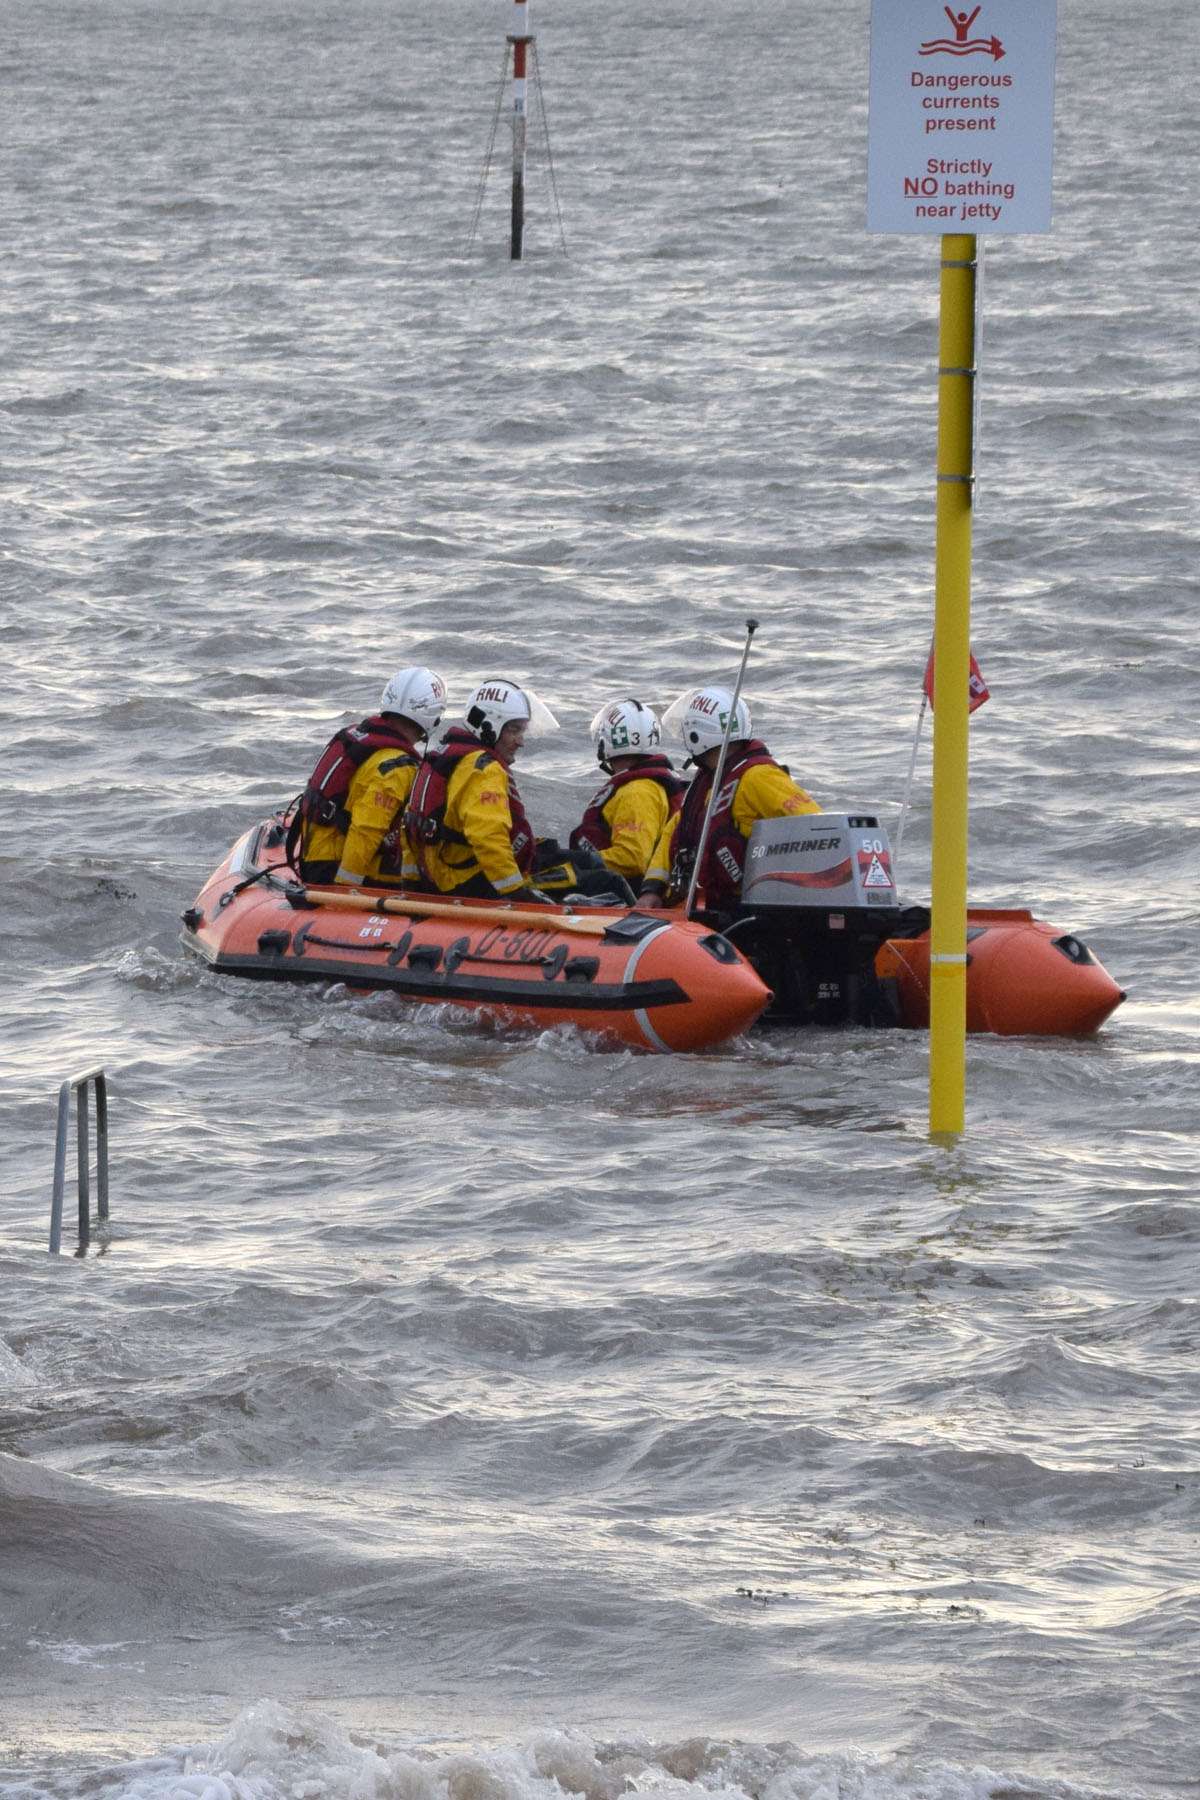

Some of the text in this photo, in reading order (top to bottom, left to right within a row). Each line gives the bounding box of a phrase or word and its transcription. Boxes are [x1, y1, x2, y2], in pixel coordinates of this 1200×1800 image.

[911, 72, 1013, 91] Dangerous
[922, 94, 1000, 109] currents
[925, 116, 997, 134] present
[926, 158, 993, 178] Strictly
[903, 177, 1015, 199] NO bathing
[915, 202, 1003, 221] near jetty
[476, 688, 509, 703] RNLI
[689, 695, 720, 715] RNLI
[631, 731, 640, 746] 3
[751, 837, 842, 859] 50 MARINER
[862, 839, 883, 854] 50
[720, 850, 742, 878] RNLI
